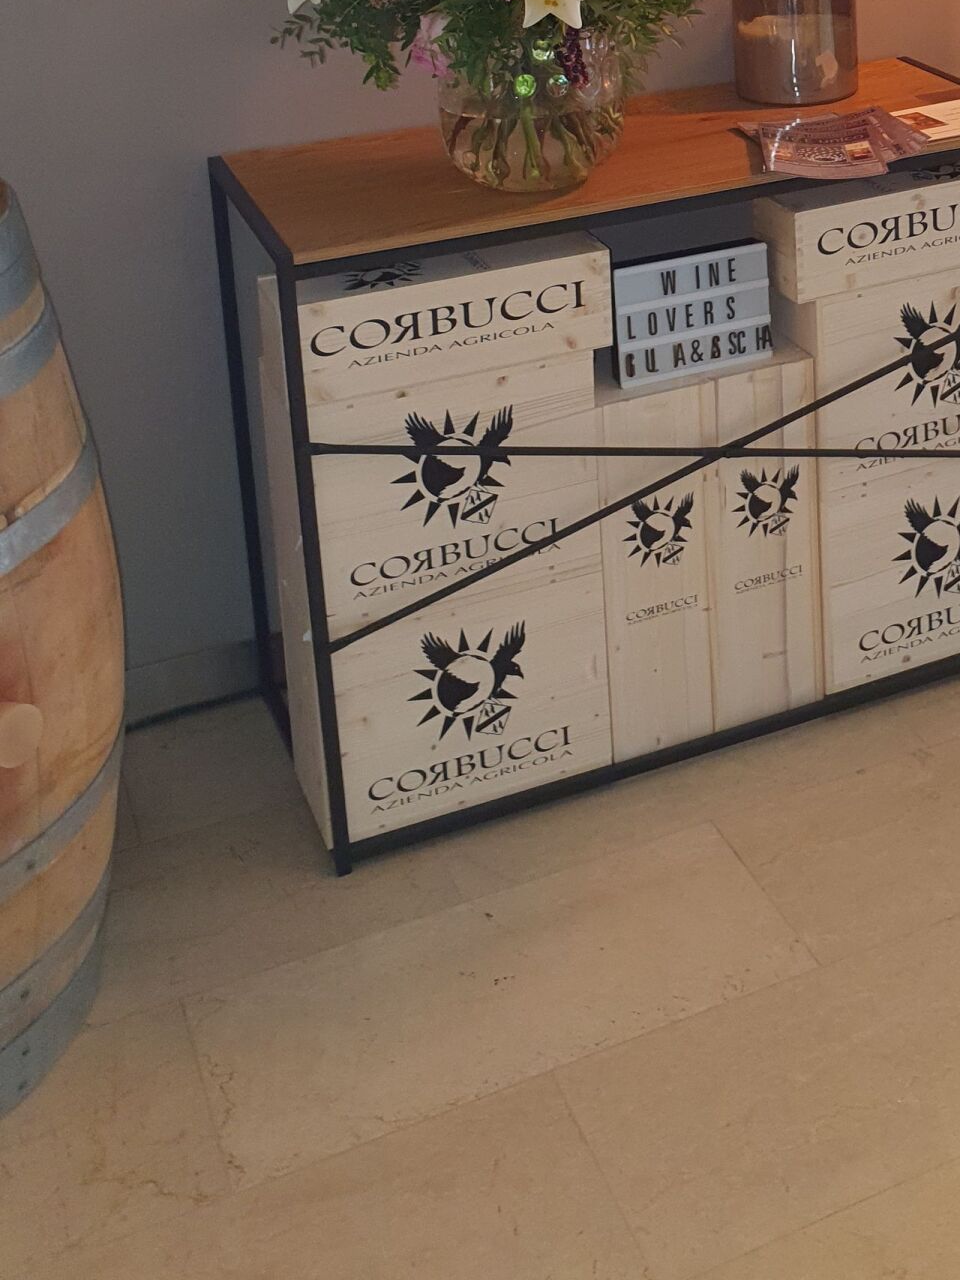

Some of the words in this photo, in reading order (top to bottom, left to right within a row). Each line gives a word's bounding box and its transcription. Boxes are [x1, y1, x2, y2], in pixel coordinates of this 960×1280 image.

[845, 244, 917, 267] AZIENDA
[660, 258, 737, 296] WINE
[626, 296, 736, 340] LOVERS
[347, 343, 443, 369] AZIENDA
[450, 321, 555, 348] AGRICOLA
[352, 571, 449, 601] AZIENDA
[860, 635, 933, 664] AZIENDA
[370, 781, 464, 815] AZIENDA
[468, 749, 574, 782] AGRICOLA
